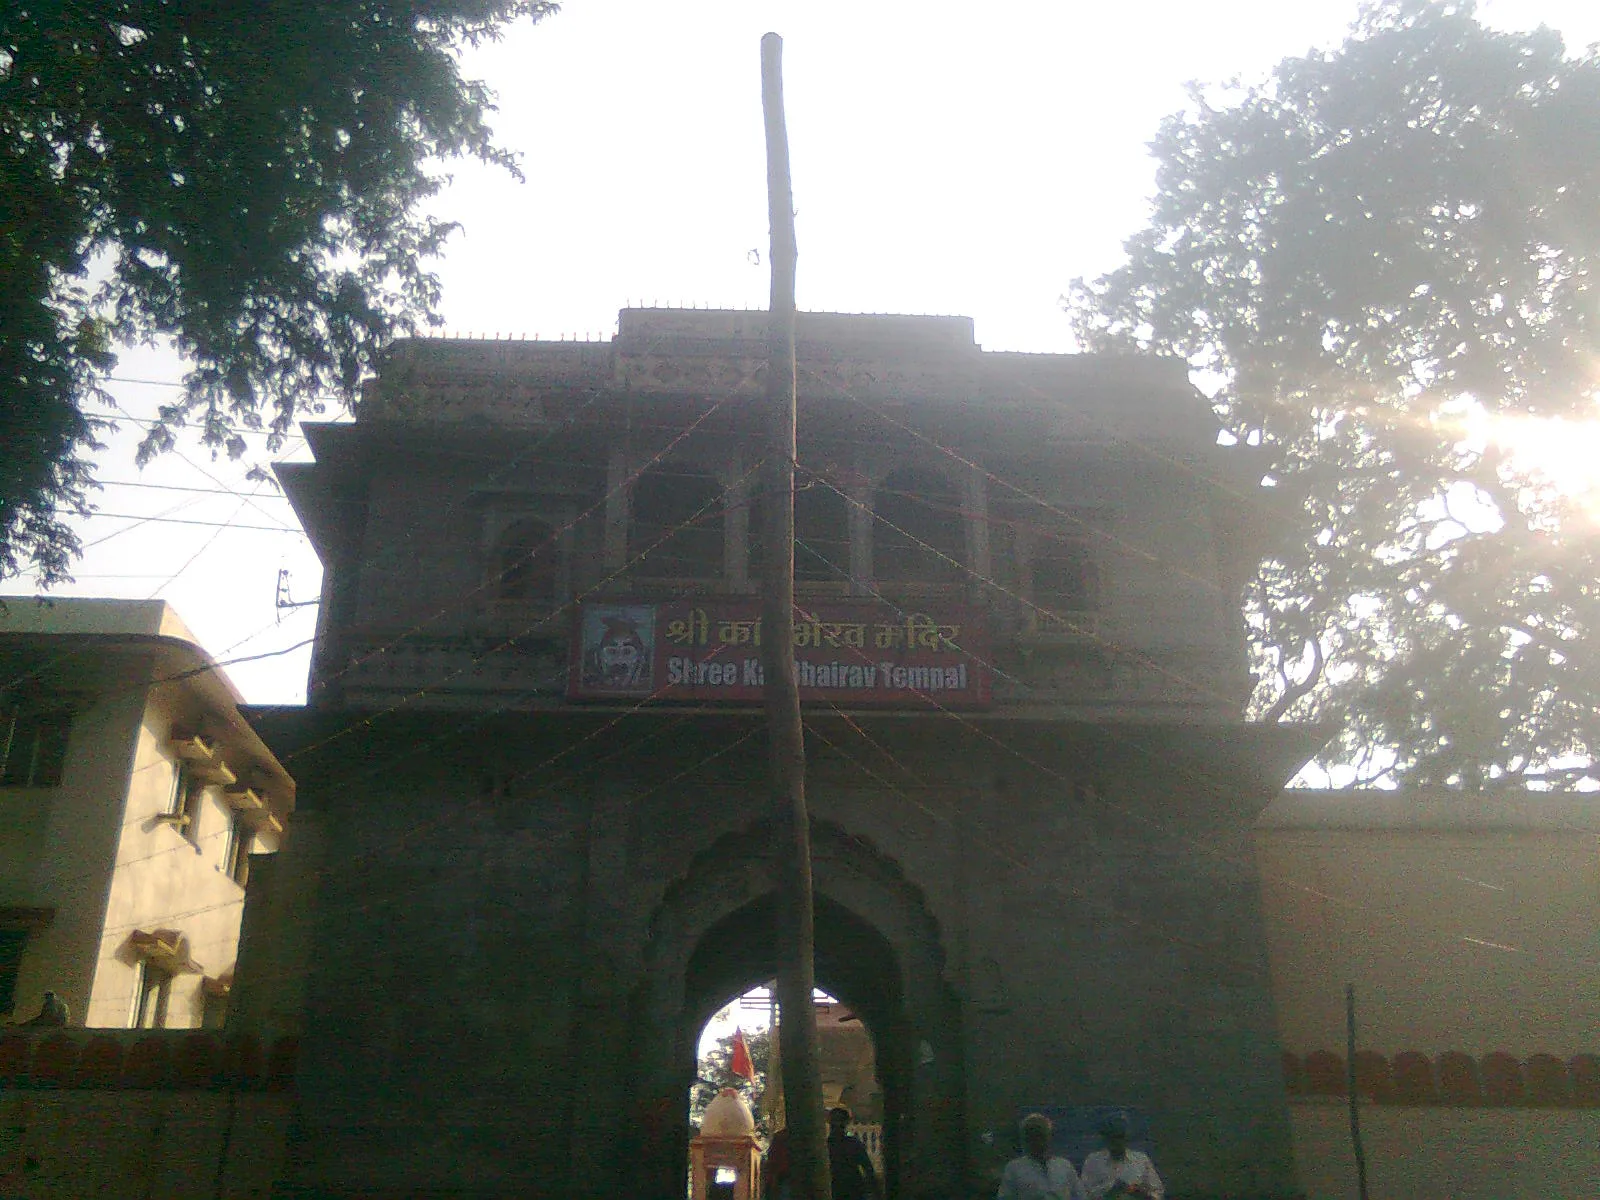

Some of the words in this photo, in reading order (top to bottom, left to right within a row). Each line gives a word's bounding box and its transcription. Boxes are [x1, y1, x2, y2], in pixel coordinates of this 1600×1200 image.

[665, 608, 709, 645] श्री
[667, 656, 737, 686] Shree
[880, 662, 967, 692] Tempal
